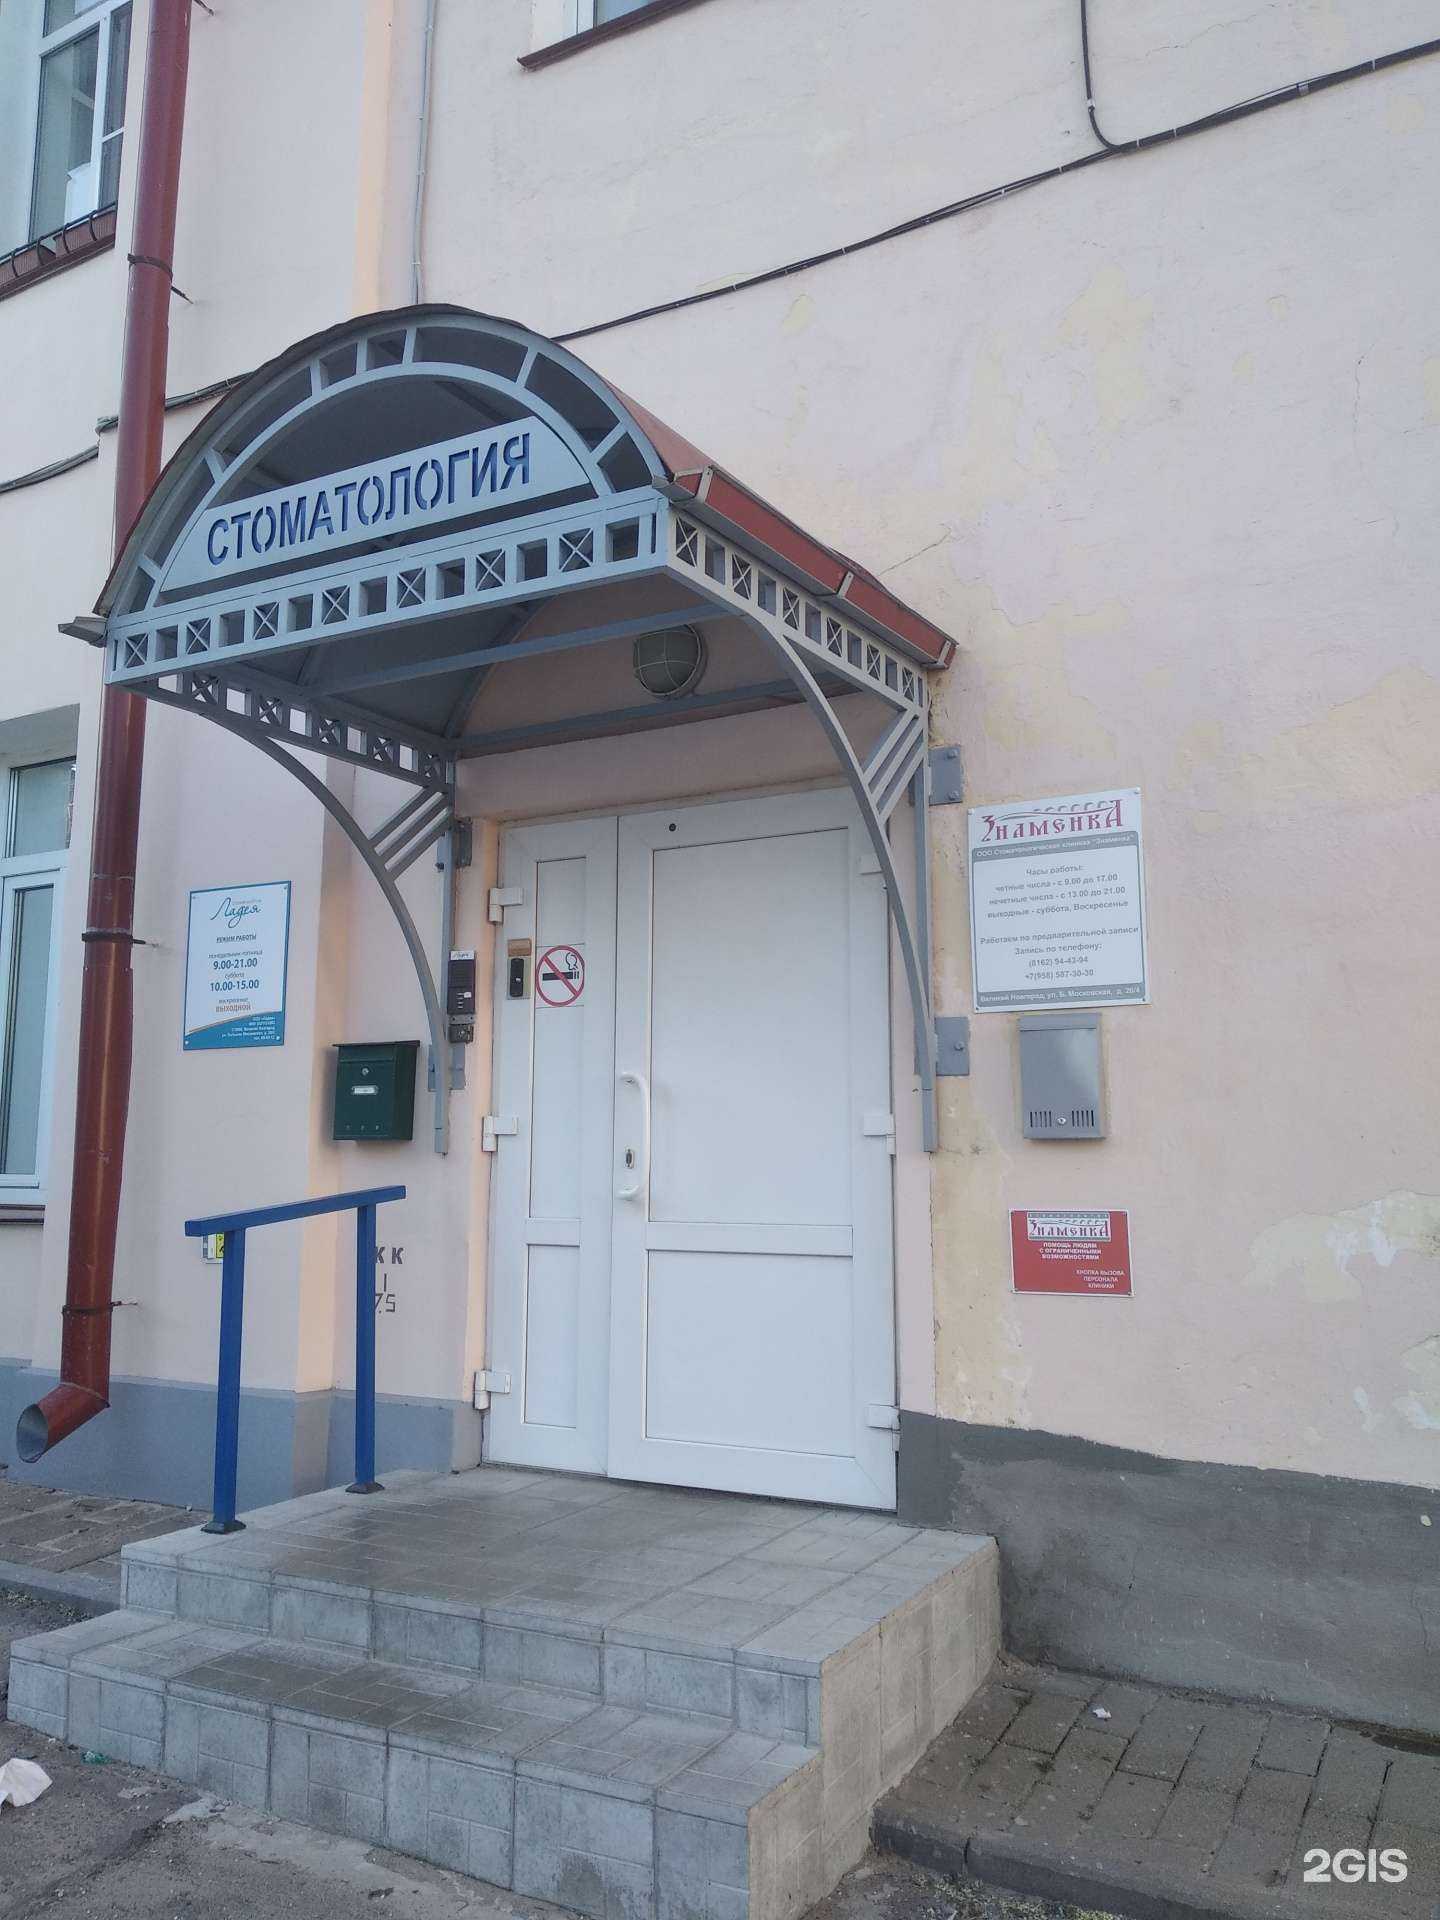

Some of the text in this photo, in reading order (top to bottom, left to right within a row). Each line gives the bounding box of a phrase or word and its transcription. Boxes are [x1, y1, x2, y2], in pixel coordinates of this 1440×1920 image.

[207, 432, 531, 566] СТОМАТОЛОГИЯ
[1026, 868, 1048, 876] Часы
[995, 884, 1024, 892] четные
[1026, 881, 1051, 889] числа
[1096, 874, 1118, 882] 17.00
[989, 896, 1027, 905] нечетные
[1029, 894, 1053, 902] числа
[1068, 890, 1089, 898] 13.00
[1091, 889, 1102, 897] до
[1104, 886, 1126, 895] 21.00
[987, 909, 1030, 918] выходные
[216, 934, 257, 943] РЕЖИМ РАБОТЫ
[980, 936, 1017, 945] Работаем
[1108, 926, 1139, 936] записи
[1015, 946, 1044, 955] Запись
[213, 957, 258, 970] 9.00-21.00
[210, 979, 260, 992] 10.00-15.00
